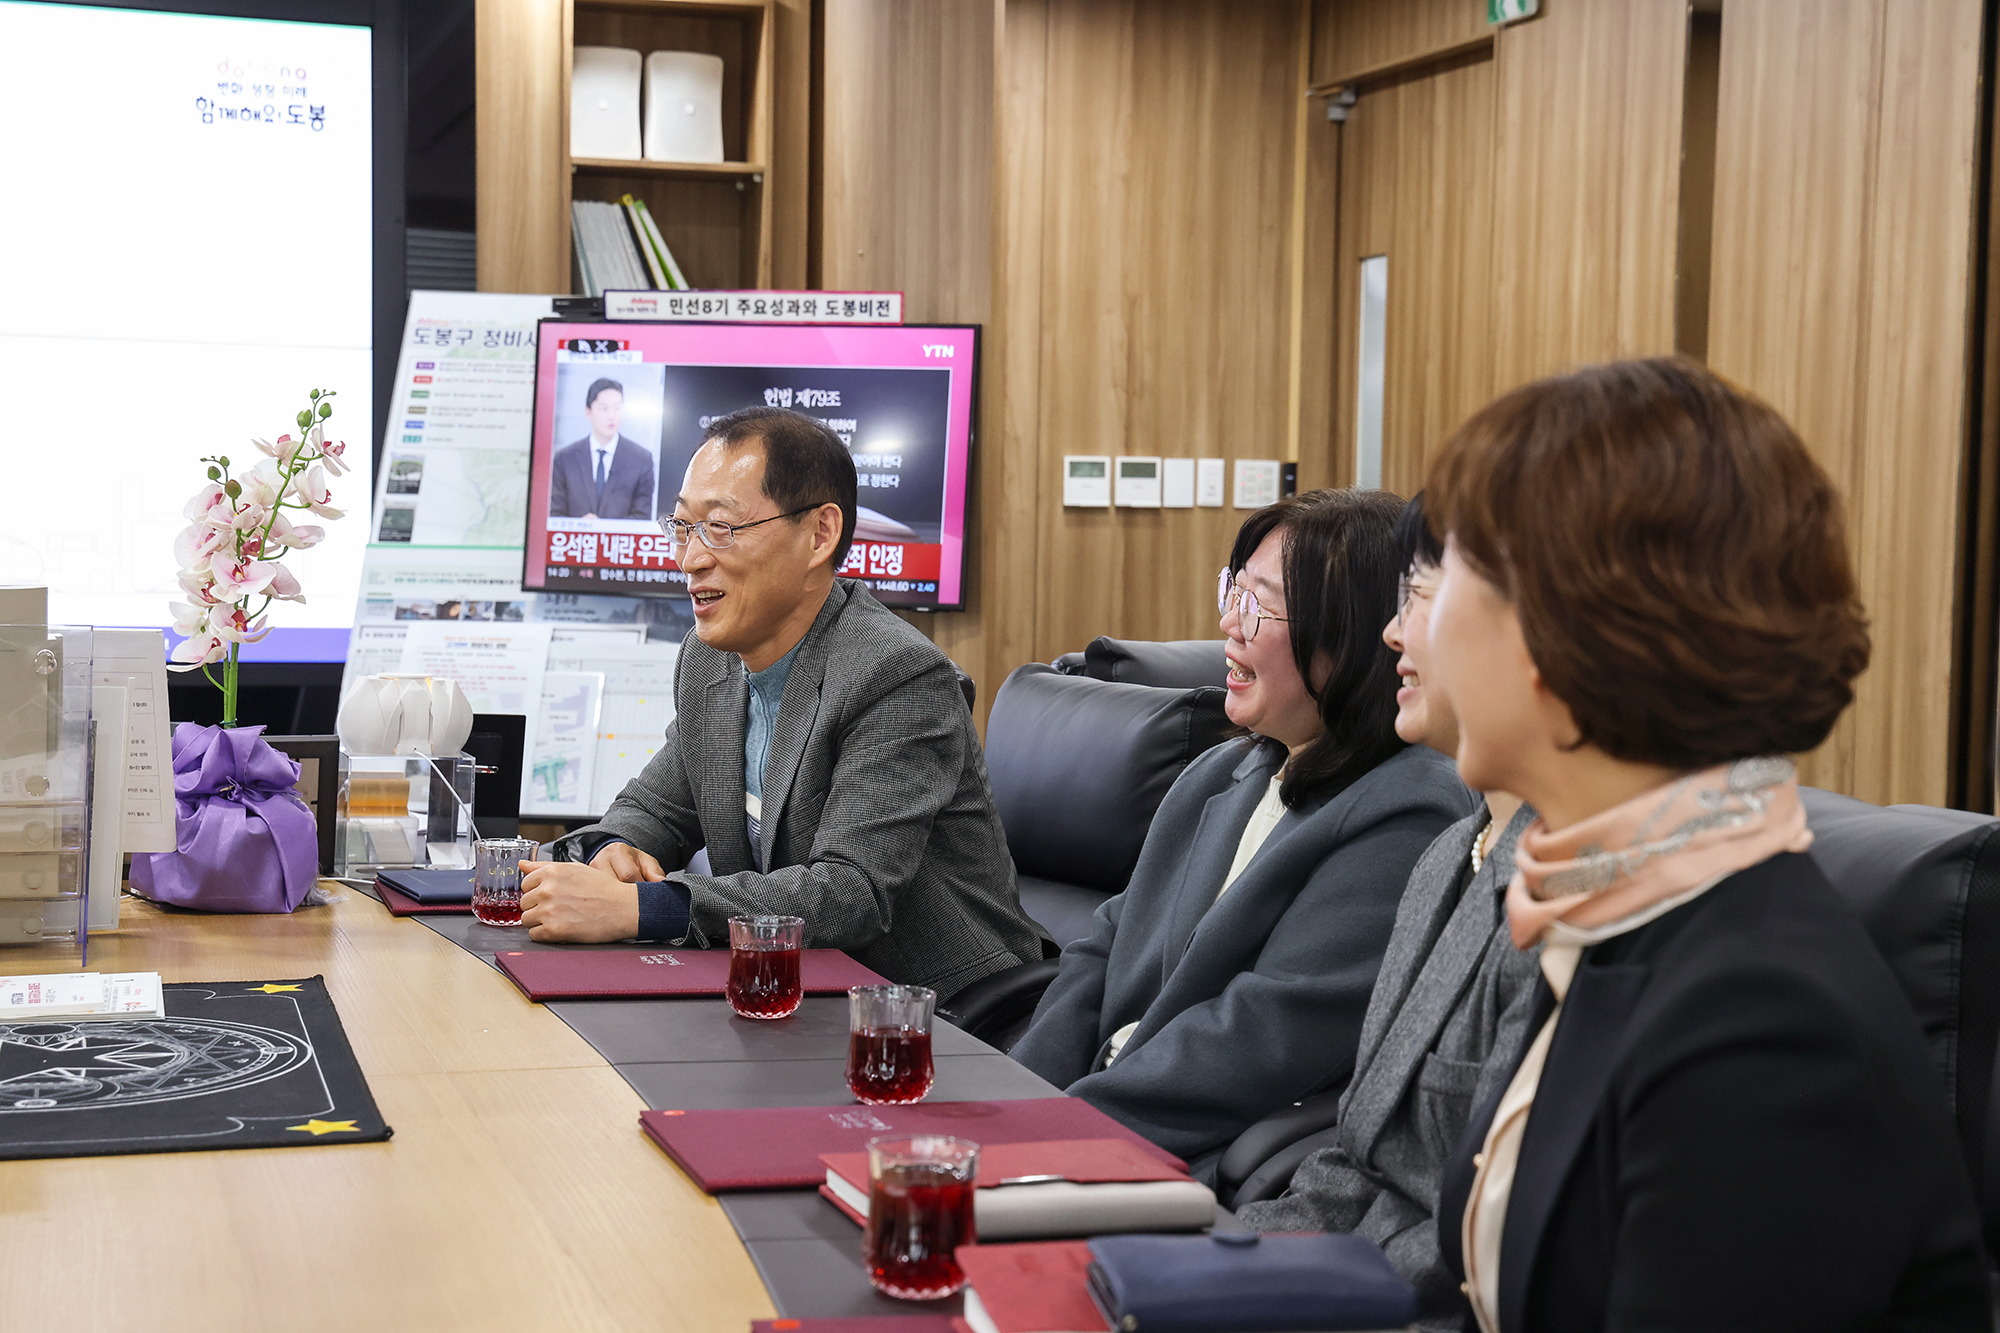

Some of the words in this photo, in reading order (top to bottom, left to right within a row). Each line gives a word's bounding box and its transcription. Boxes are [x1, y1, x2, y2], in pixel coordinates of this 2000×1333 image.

[286, 103, 326, 132] 도봉
[669, 298, 729, 316] 민선8기
[736, 298, 818, 317] 주요성과와
[825, 299, 890, 318] 도봉비전
[413, 327, 473, 347] 도봉구
[922, 344, 955, 358] YTN
[763, 386, 793, 408] 헌법
[795, 386, 842, 409] 제79조
[550, 532, 598, 564] 윤석열
[868, 543, 904, 576] 인정
